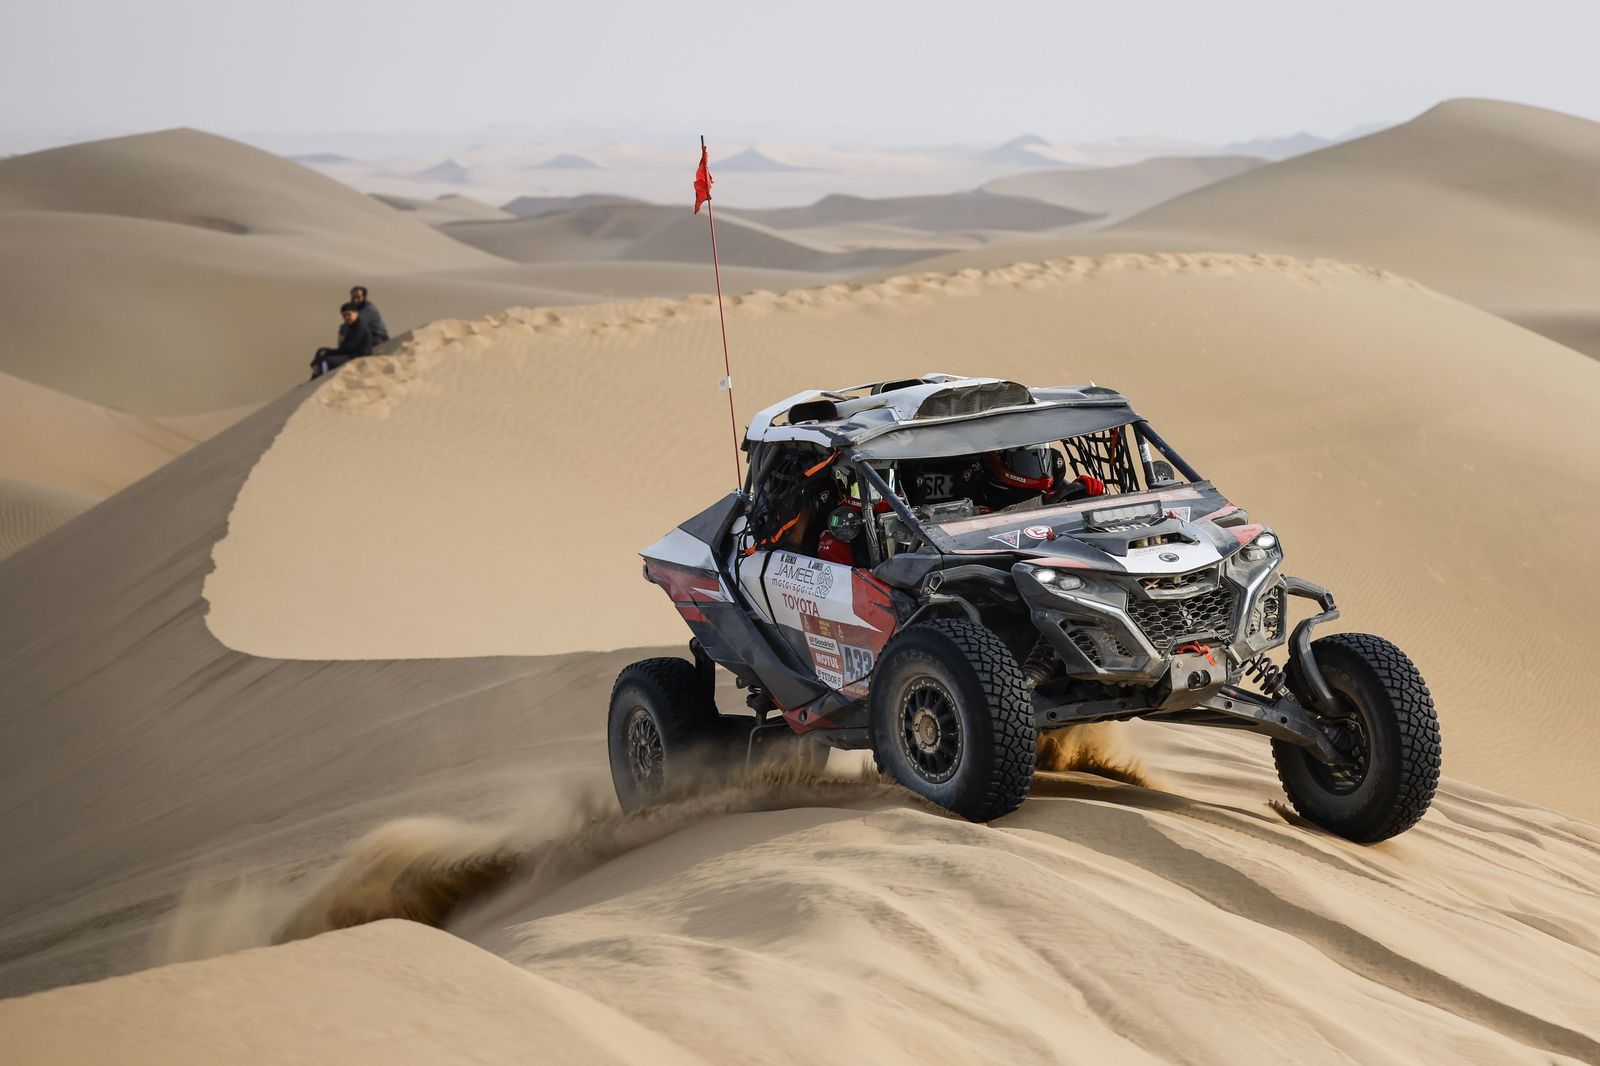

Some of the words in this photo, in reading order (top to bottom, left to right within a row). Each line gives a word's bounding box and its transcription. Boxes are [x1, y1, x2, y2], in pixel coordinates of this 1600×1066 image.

[774, 563, 815, 585] JAMEEL
[782, 593, 820, 616] TOYOTA
[809, 636, 836, 648] BFGoodrich
[815, 652, 840, 669] MOTUL
[844, 646, 872, 681] 433
[822, 671, 838, 684] TUDOR
